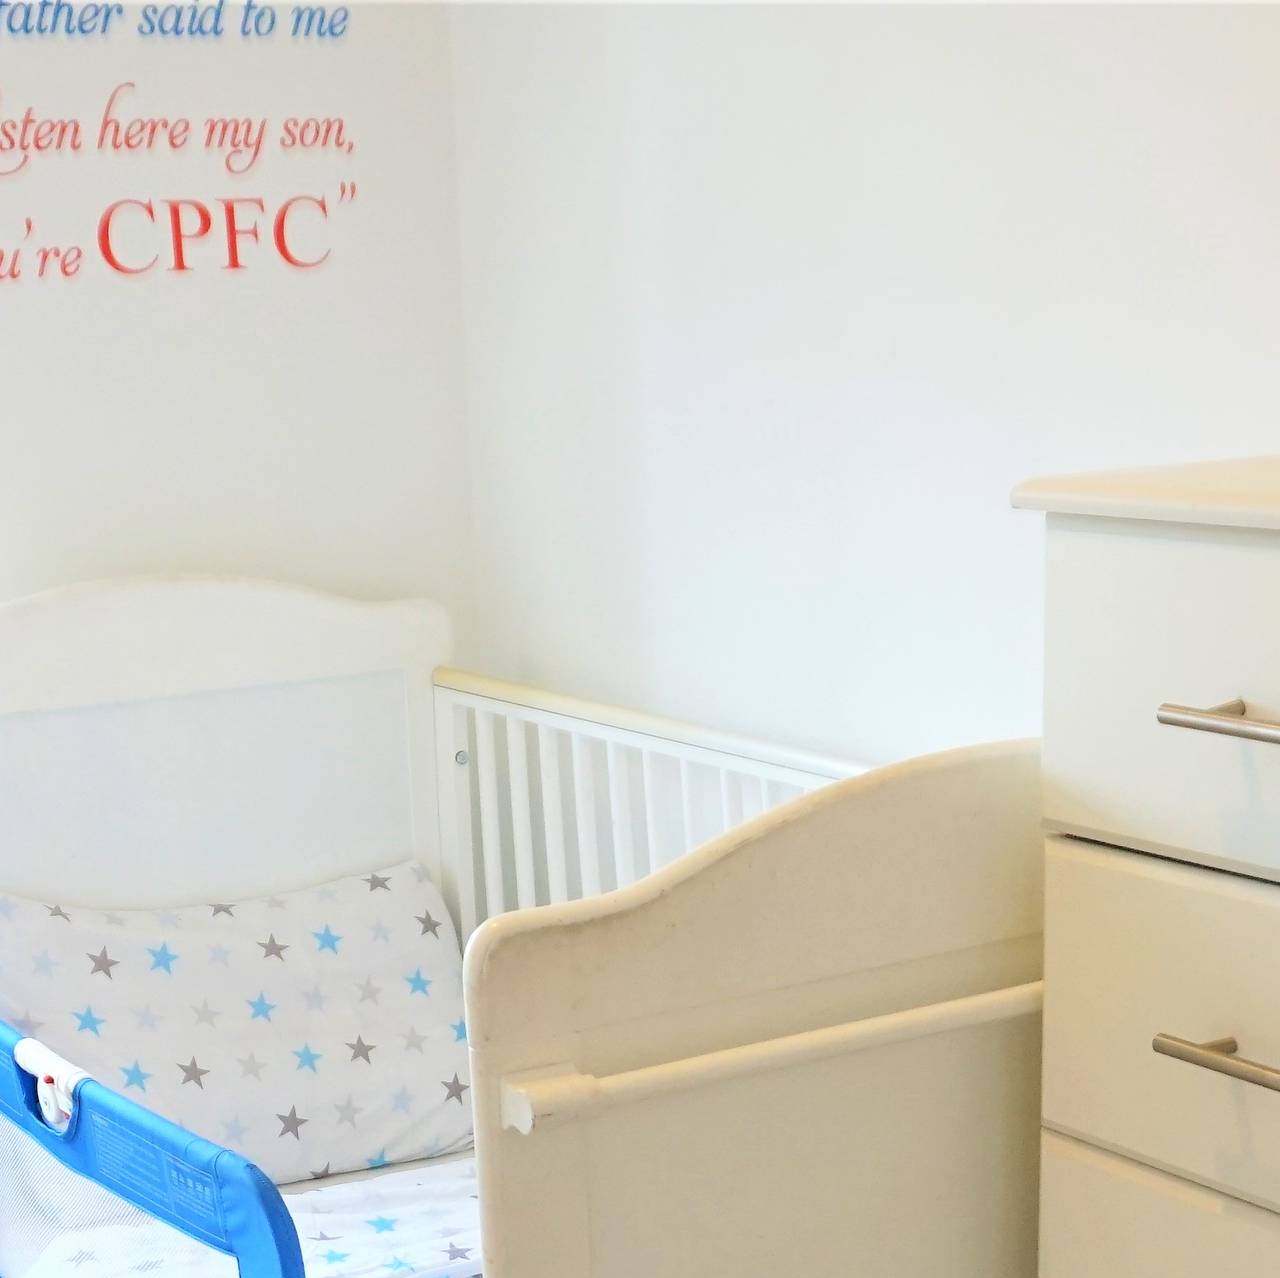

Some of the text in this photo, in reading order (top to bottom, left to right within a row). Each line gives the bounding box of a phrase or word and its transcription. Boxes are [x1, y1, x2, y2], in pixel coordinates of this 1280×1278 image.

[138, 0, 223, 36] said
[241, 0, 277, 36] to
[291, 5, 349, 37] me
[97, 82, 189, 150] here
[204, 117, 266, 174] my
[280, 117, 355, 153] son,
